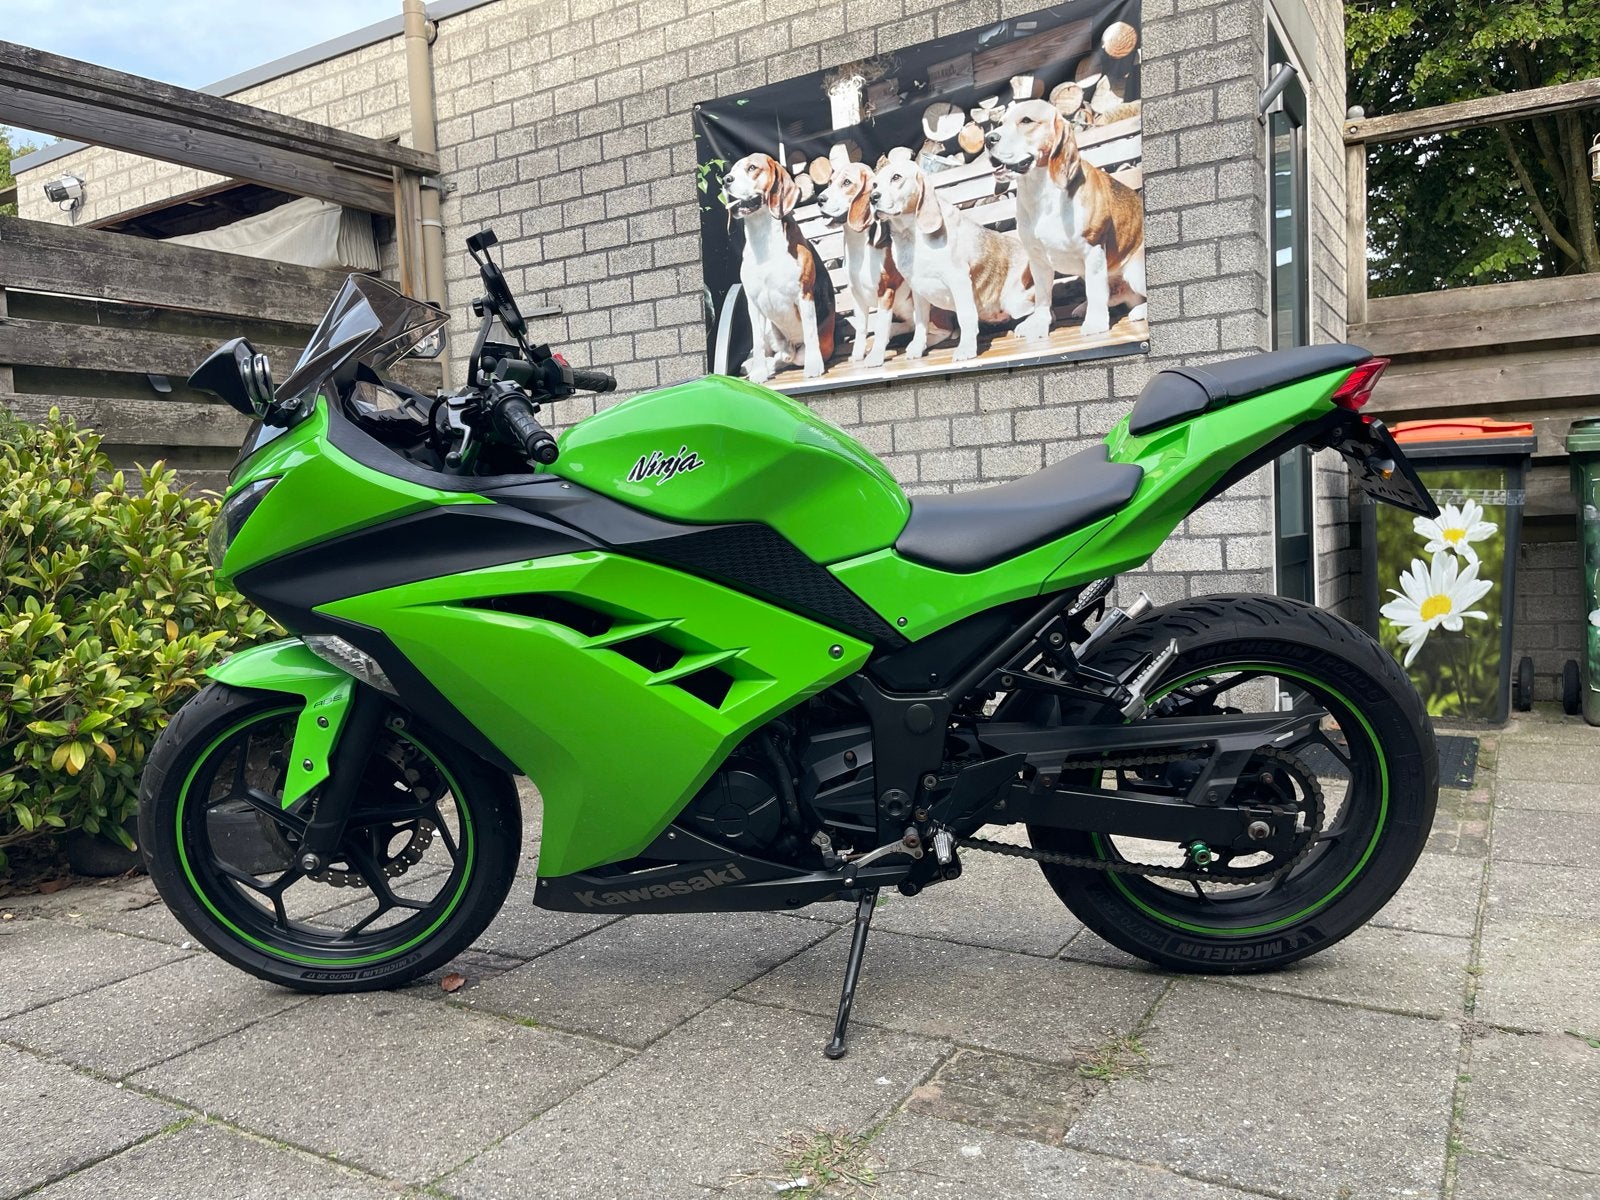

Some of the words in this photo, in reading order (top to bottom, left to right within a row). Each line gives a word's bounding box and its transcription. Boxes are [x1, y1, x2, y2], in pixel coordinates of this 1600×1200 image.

[627, 445, 705, 486] Ninja
[314, 694, 343, 708] ABS
[573, 863, 746, 907] Kawasaki
[1175, 940, 1283, 961] MICHELIN
[362, 959, 407, 978] MICHELIN
